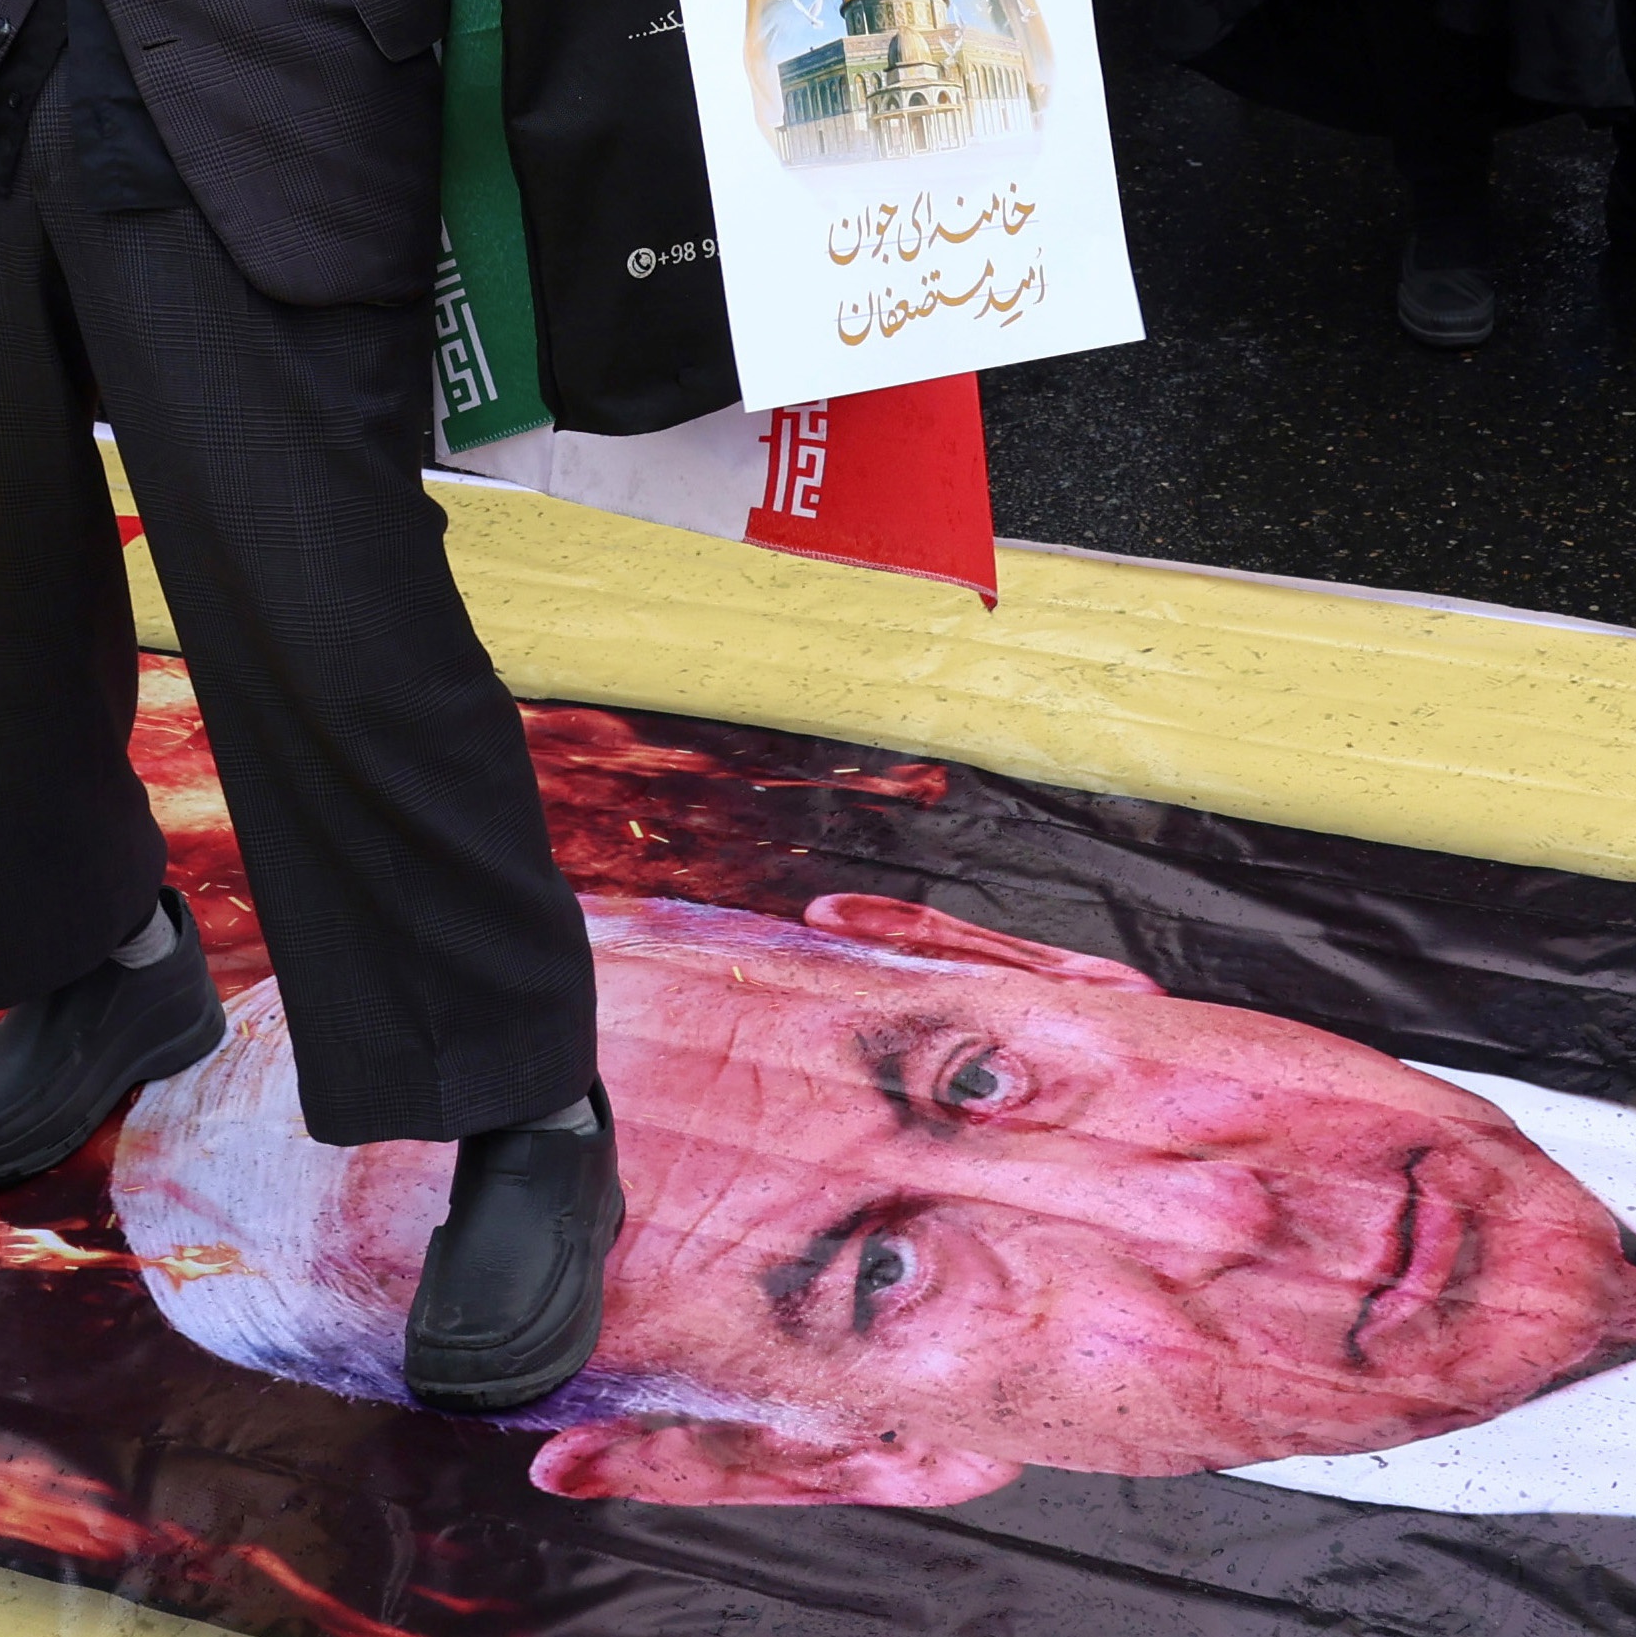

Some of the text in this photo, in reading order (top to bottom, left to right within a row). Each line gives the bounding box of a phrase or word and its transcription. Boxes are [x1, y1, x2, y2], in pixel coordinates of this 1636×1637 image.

[658, 241, 697, 266] +98
[828, 204, 900, 266] جوان
[837, 257, 996, 347] مستضعفان
